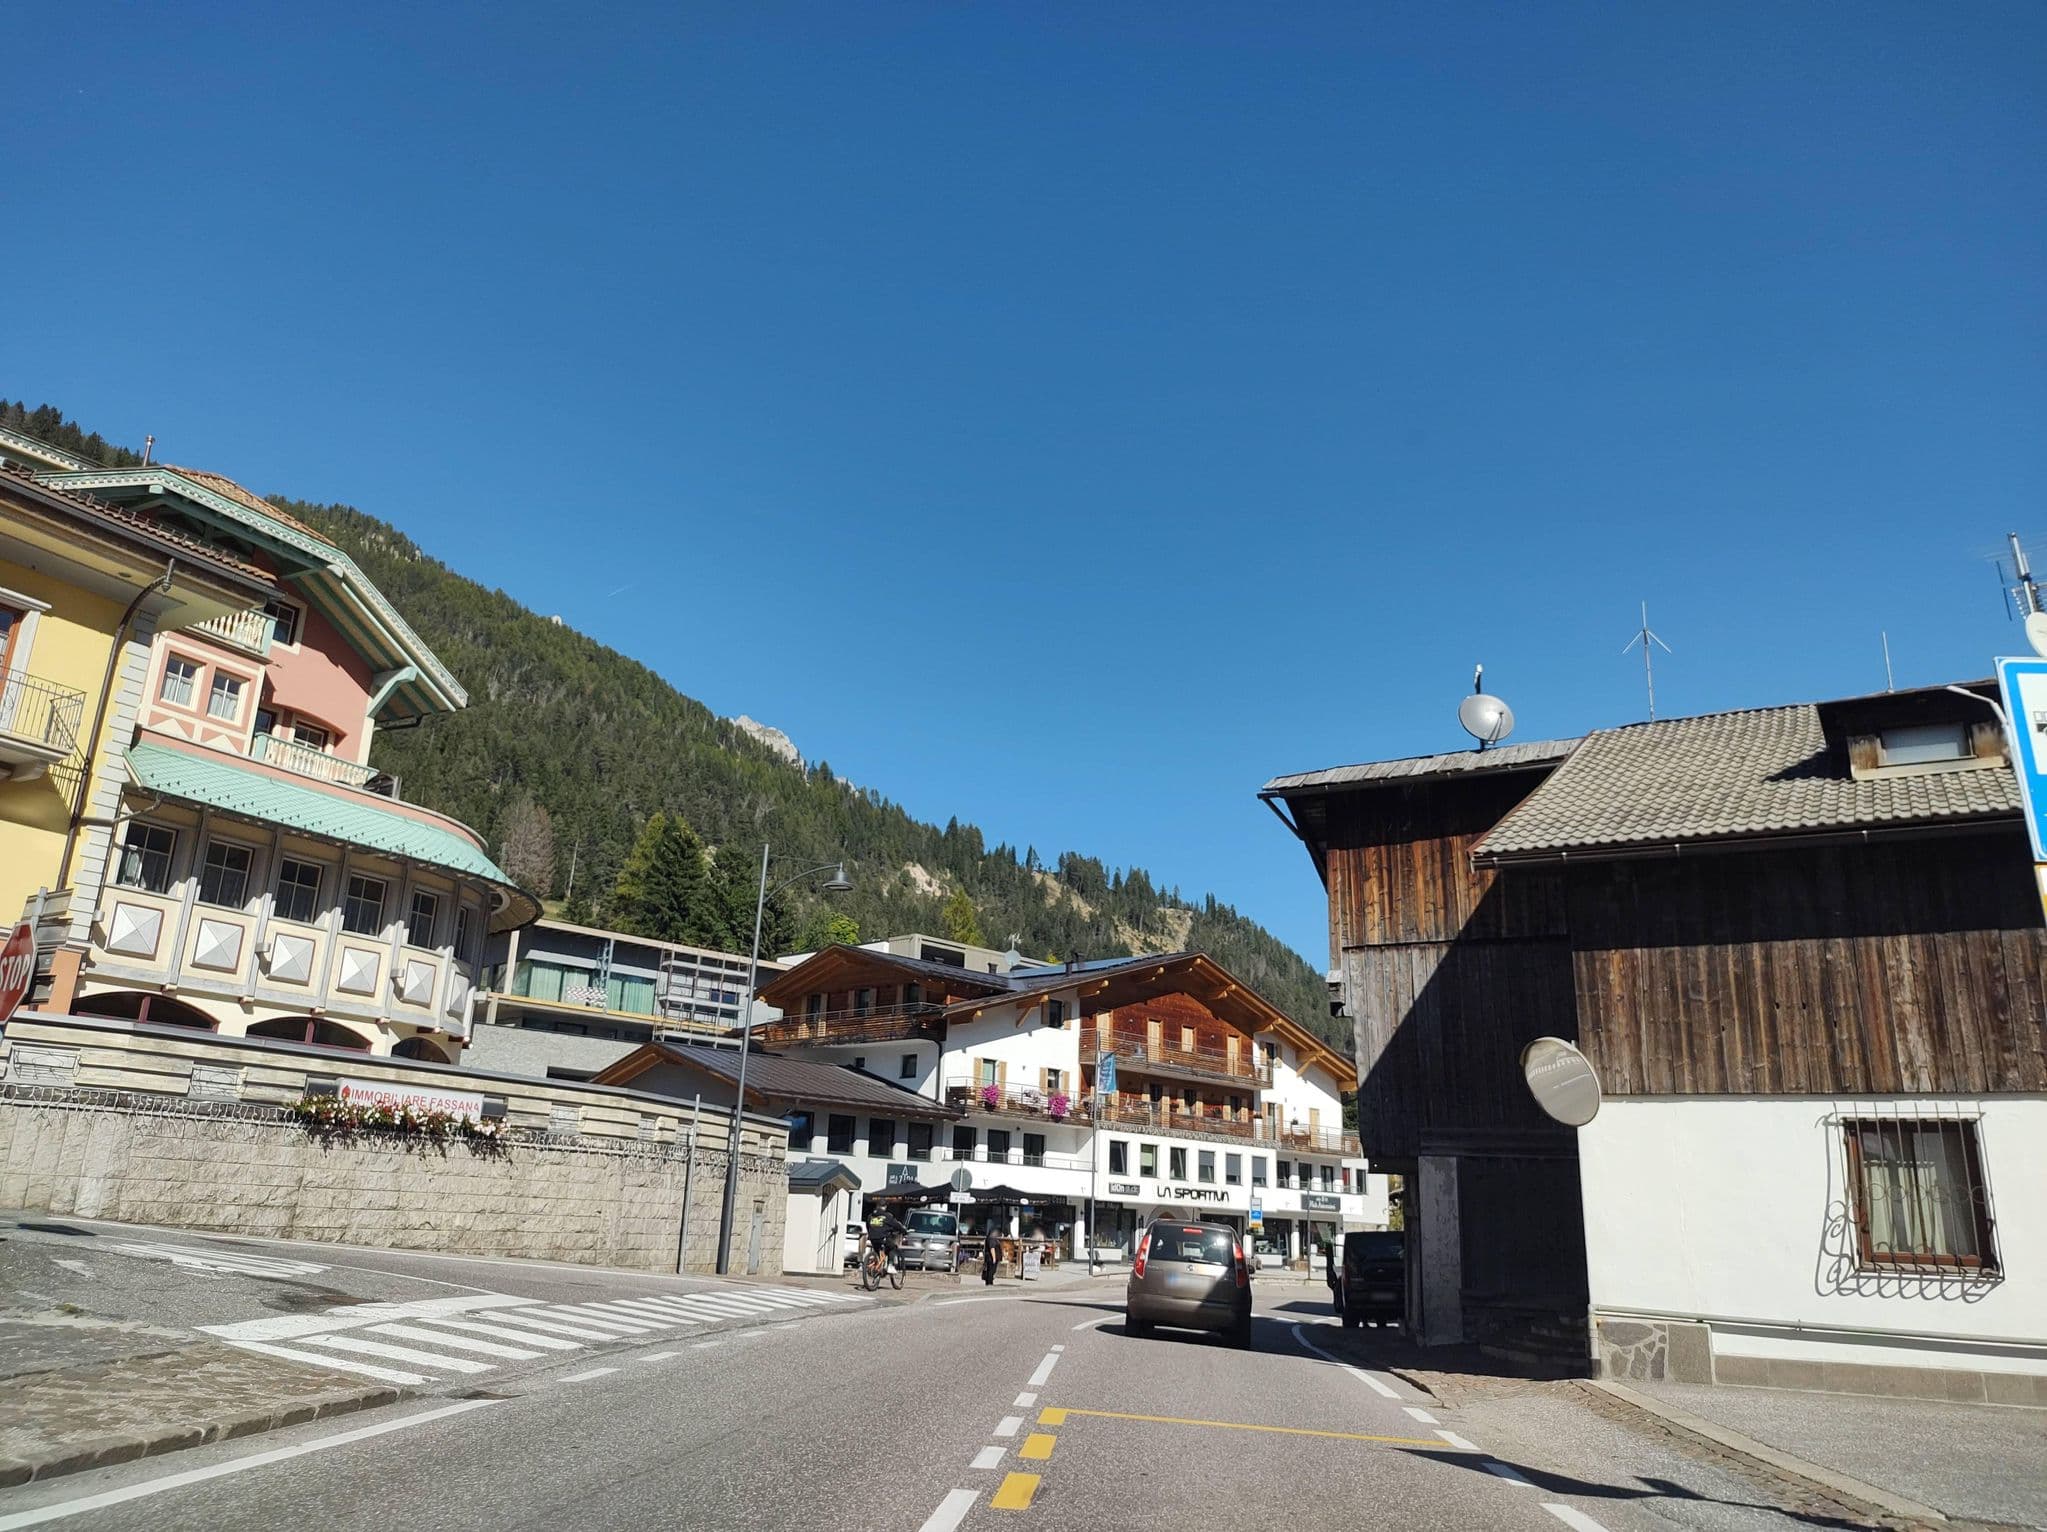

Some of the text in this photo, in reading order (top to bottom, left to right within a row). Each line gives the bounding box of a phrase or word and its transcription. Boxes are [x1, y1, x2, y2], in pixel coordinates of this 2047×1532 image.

[0, 954, 31, 992] STOP
[352, 1088, 480, 1112] IMMOBILIARE FASSANA
[1157, 1185, 1230, 1202] LA SPORTIVA
